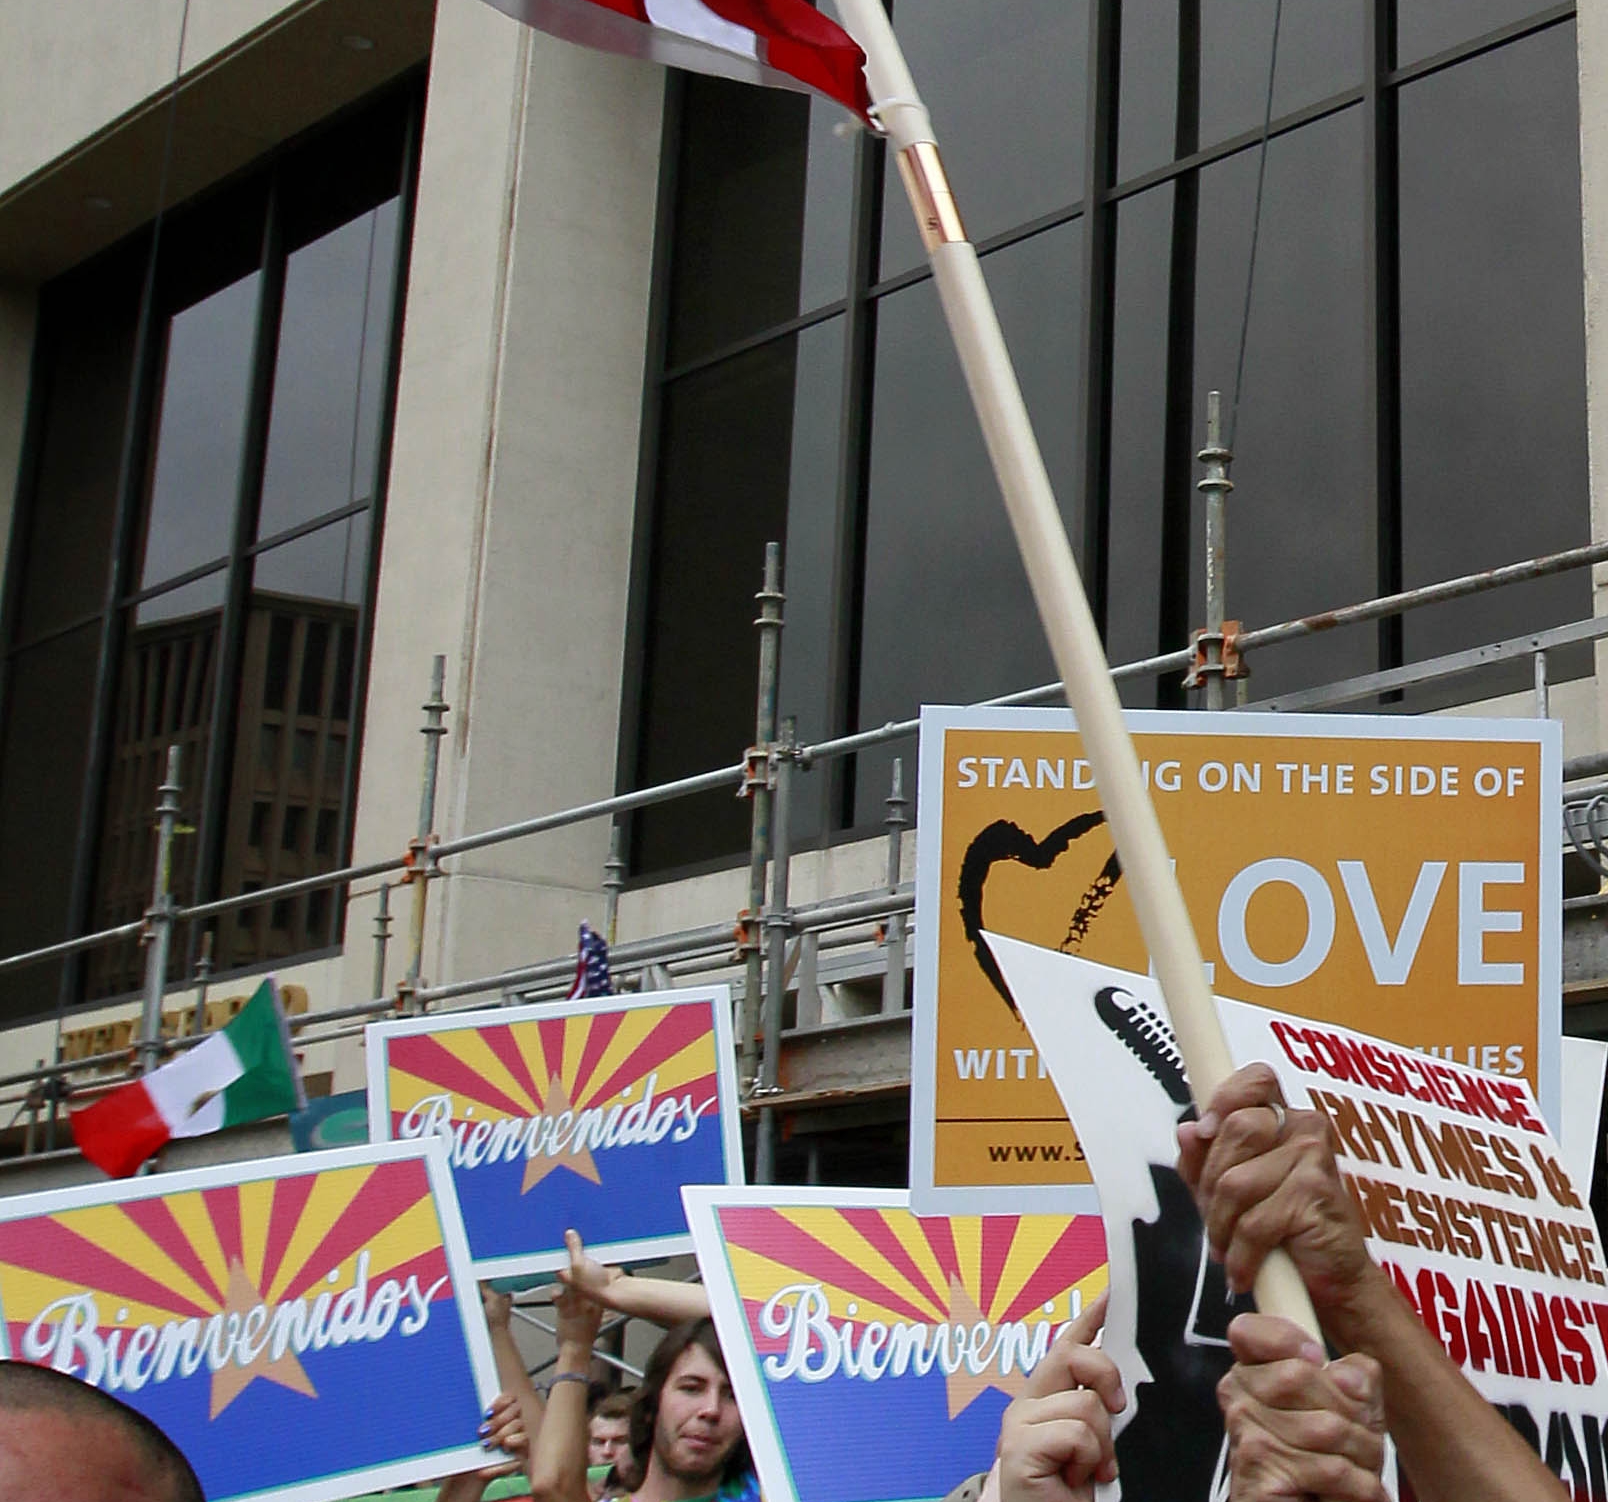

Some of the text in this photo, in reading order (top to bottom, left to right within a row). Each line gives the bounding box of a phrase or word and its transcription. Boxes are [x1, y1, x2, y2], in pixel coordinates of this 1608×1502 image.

[957, 757, 1525, 798] STANDG ON THE SIDE OF
[1149, 858, 1524, 987] OVE
[400, 1072, 717, 1170] Bienvenidos
[1271, 1021, 1546, 1135] CONSCIENCE
[1306, 1087, 1583, 1210] RHYMES &
[1340, 1172, 1606, 1286] RESISTENCE
[22, 1250, 448, 1392] Bienvenidos
[759, 1284, 1105, 1382] Bienveni
